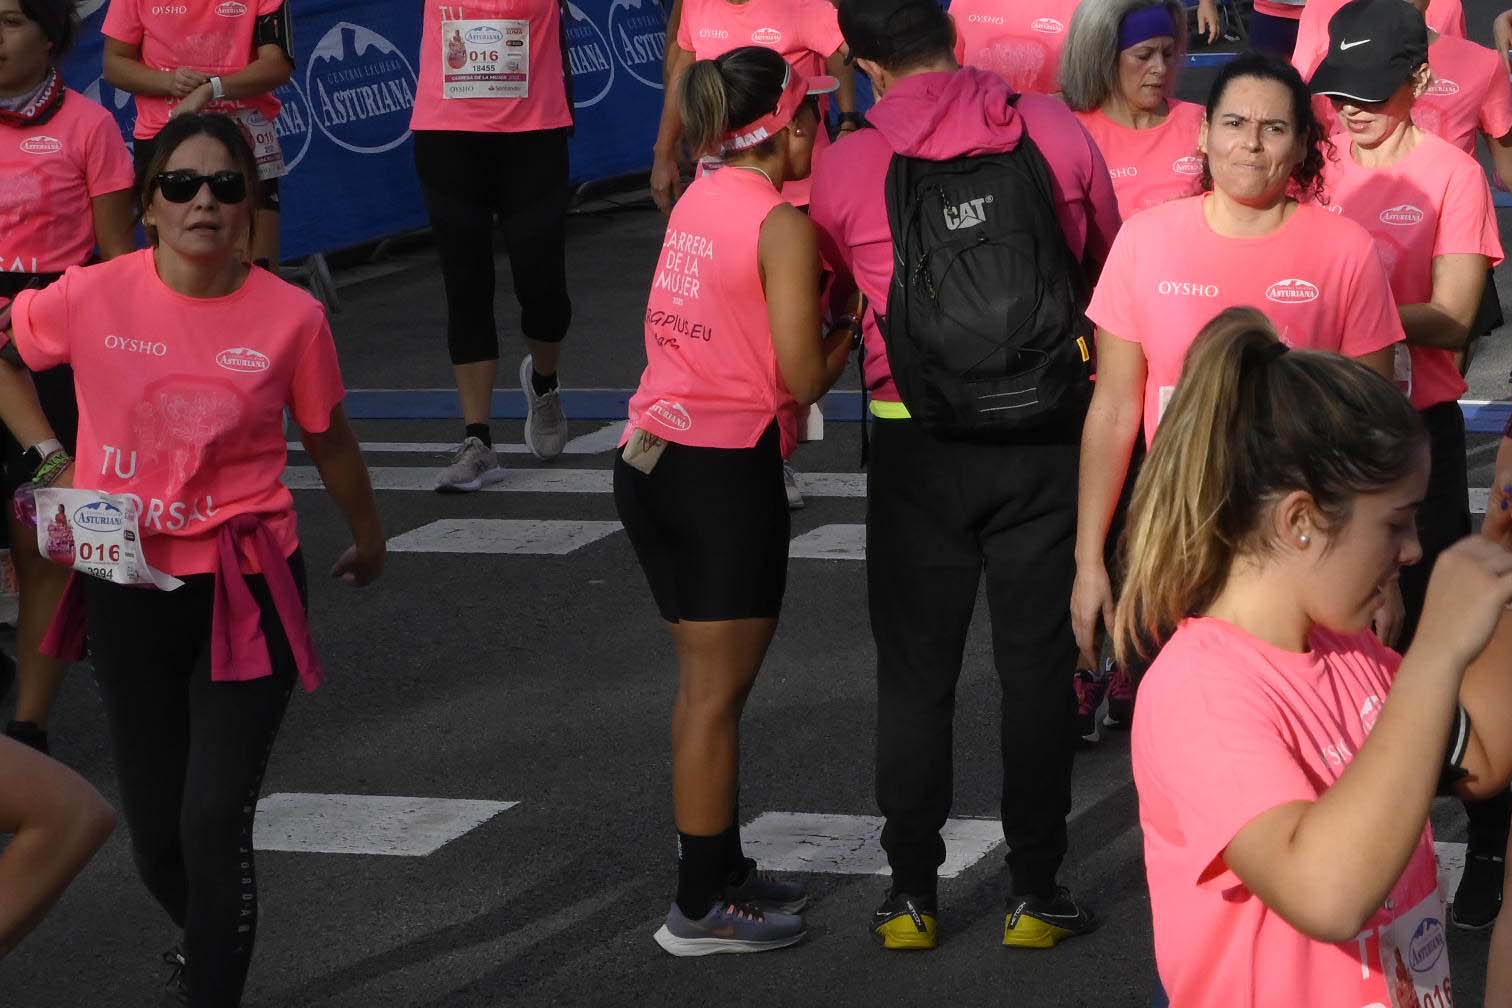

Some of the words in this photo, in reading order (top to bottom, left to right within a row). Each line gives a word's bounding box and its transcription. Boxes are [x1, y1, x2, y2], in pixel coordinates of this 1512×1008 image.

[152, 4, 187, 16] OYSHO
[470, 51, 499, 62] 016
[321, 74, 414, 128] ASTURIANA
[943, 197, 987, 231] CAT
[663, 228, 714, 260] CARRERA
[666, 250, 682, 272] DE
[686, 255, 699, 276] LA
[655, 274, 700, 299] MUJER
[1158, 280, 1219, 298] OYSHO
[1267, 283, 1315, 299] ASTURIANA
[104, 335, 167, 357] OYSHO
[220, 352, 267, 370] ASTURIANA
[101, 445, 137, 479] TU
[79, 542, 120, 562] 016
